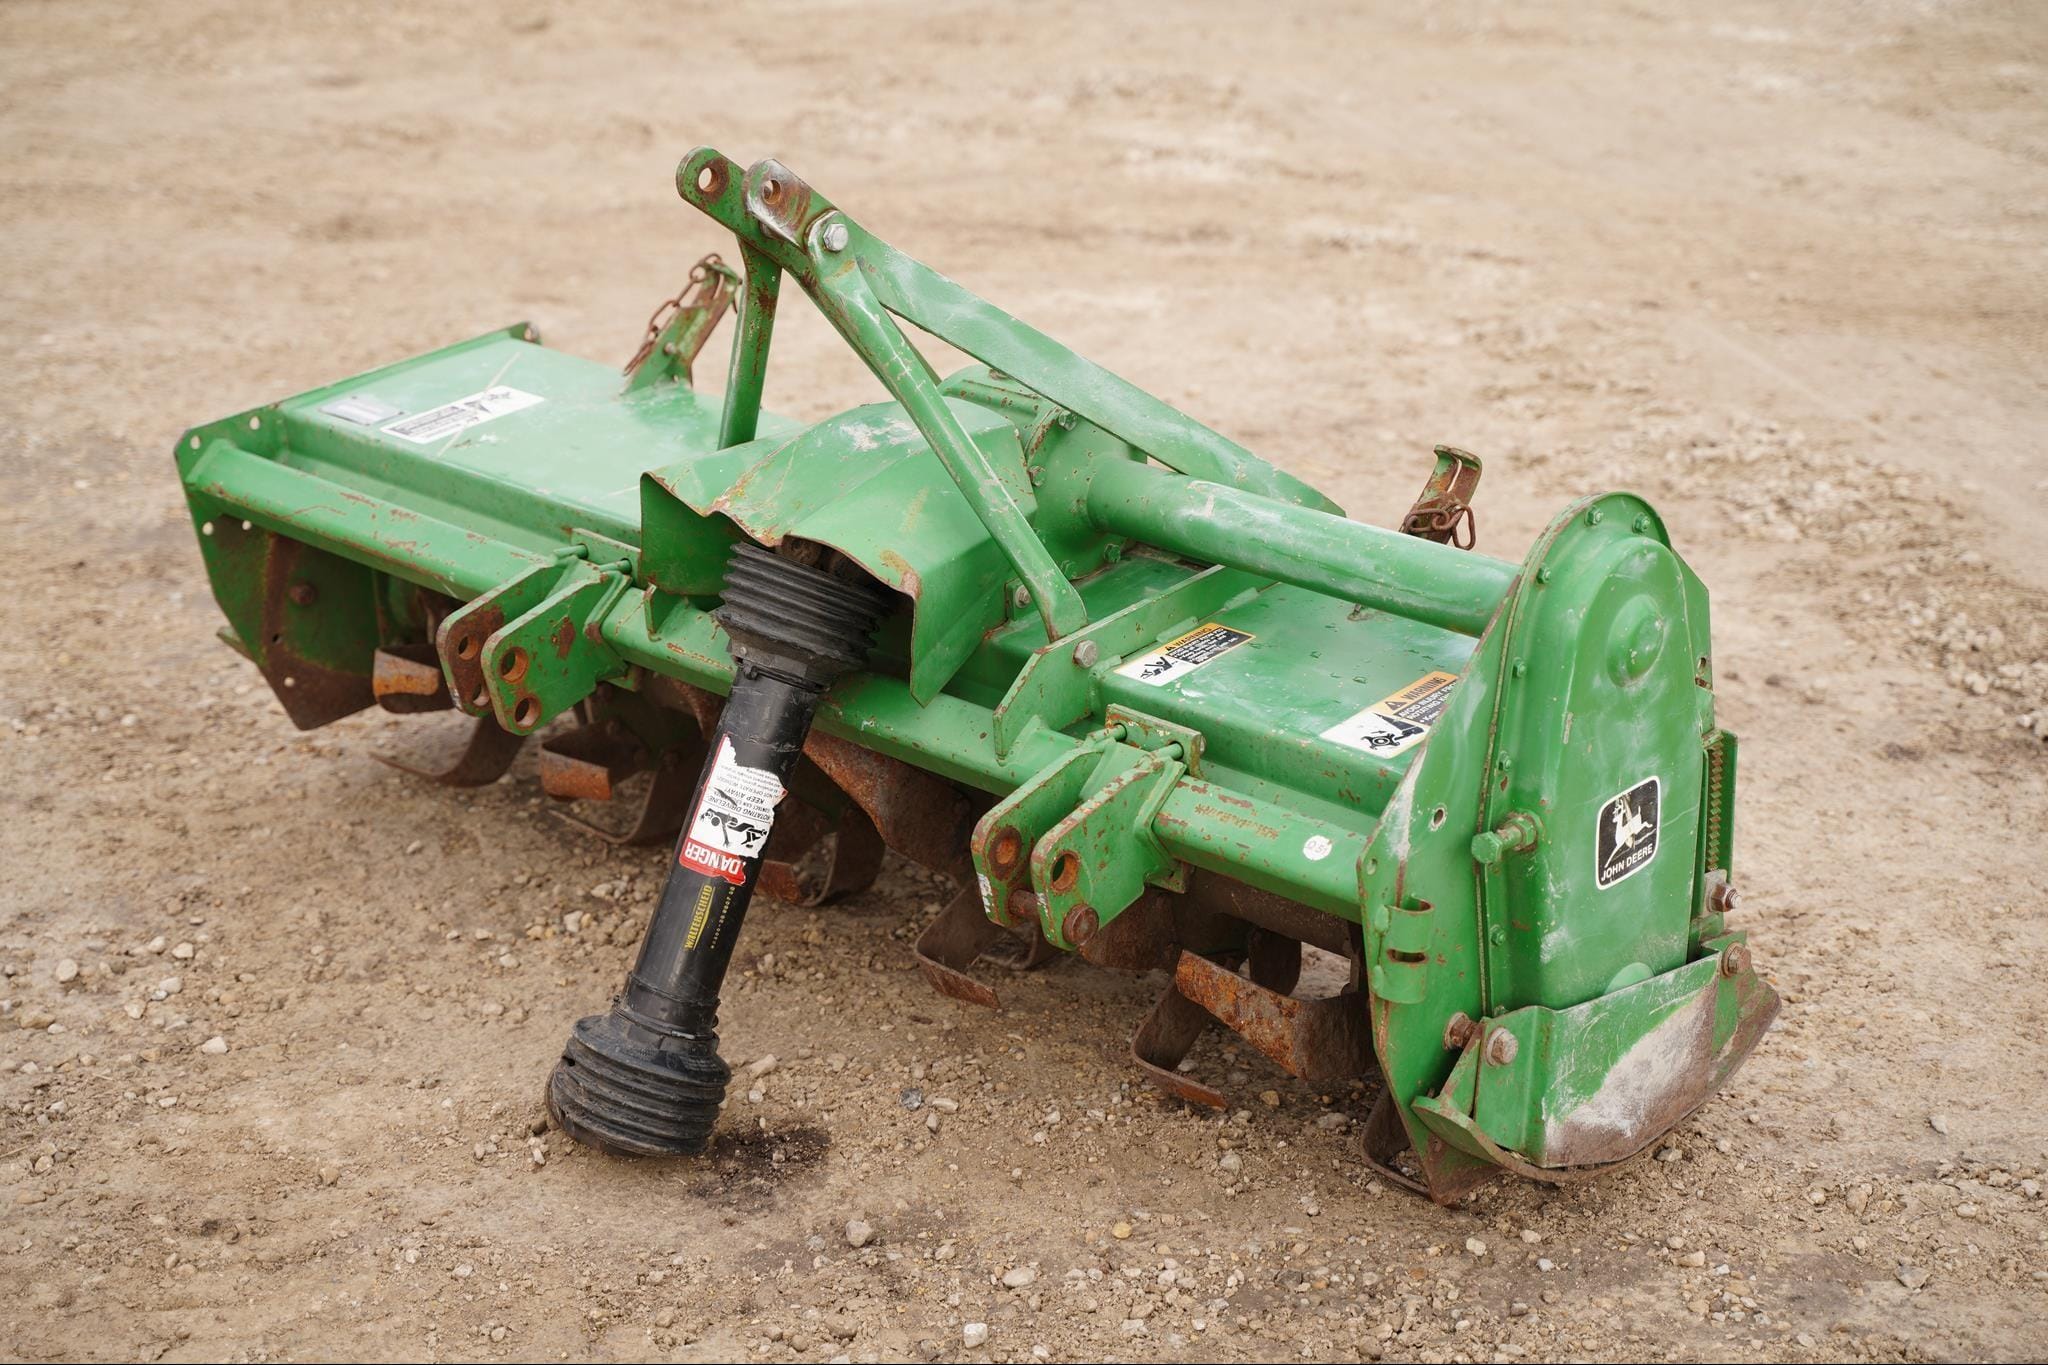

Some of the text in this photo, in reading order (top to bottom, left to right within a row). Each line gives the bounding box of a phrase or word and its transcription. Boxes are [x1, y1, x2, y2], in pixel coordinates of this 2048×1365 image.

[1400, 676, 1447, 700] WARNING
[1399, 704, 1421, 717] AVOID
[1418, 690, 1442, 706] INJURY
[1406, 700, 1442, 720] ROTATING
[709, 795, 742, 813] DRIVELINE
[746, 796, 766, 804] KEEP
[742, 808, 770, 821] ROTATING
[684, 841, 743, 875] DANGER
[1601, 843, 1653, 882] JOHN DEERE
[684, 884, 713, 949] WALTERSCHEID
